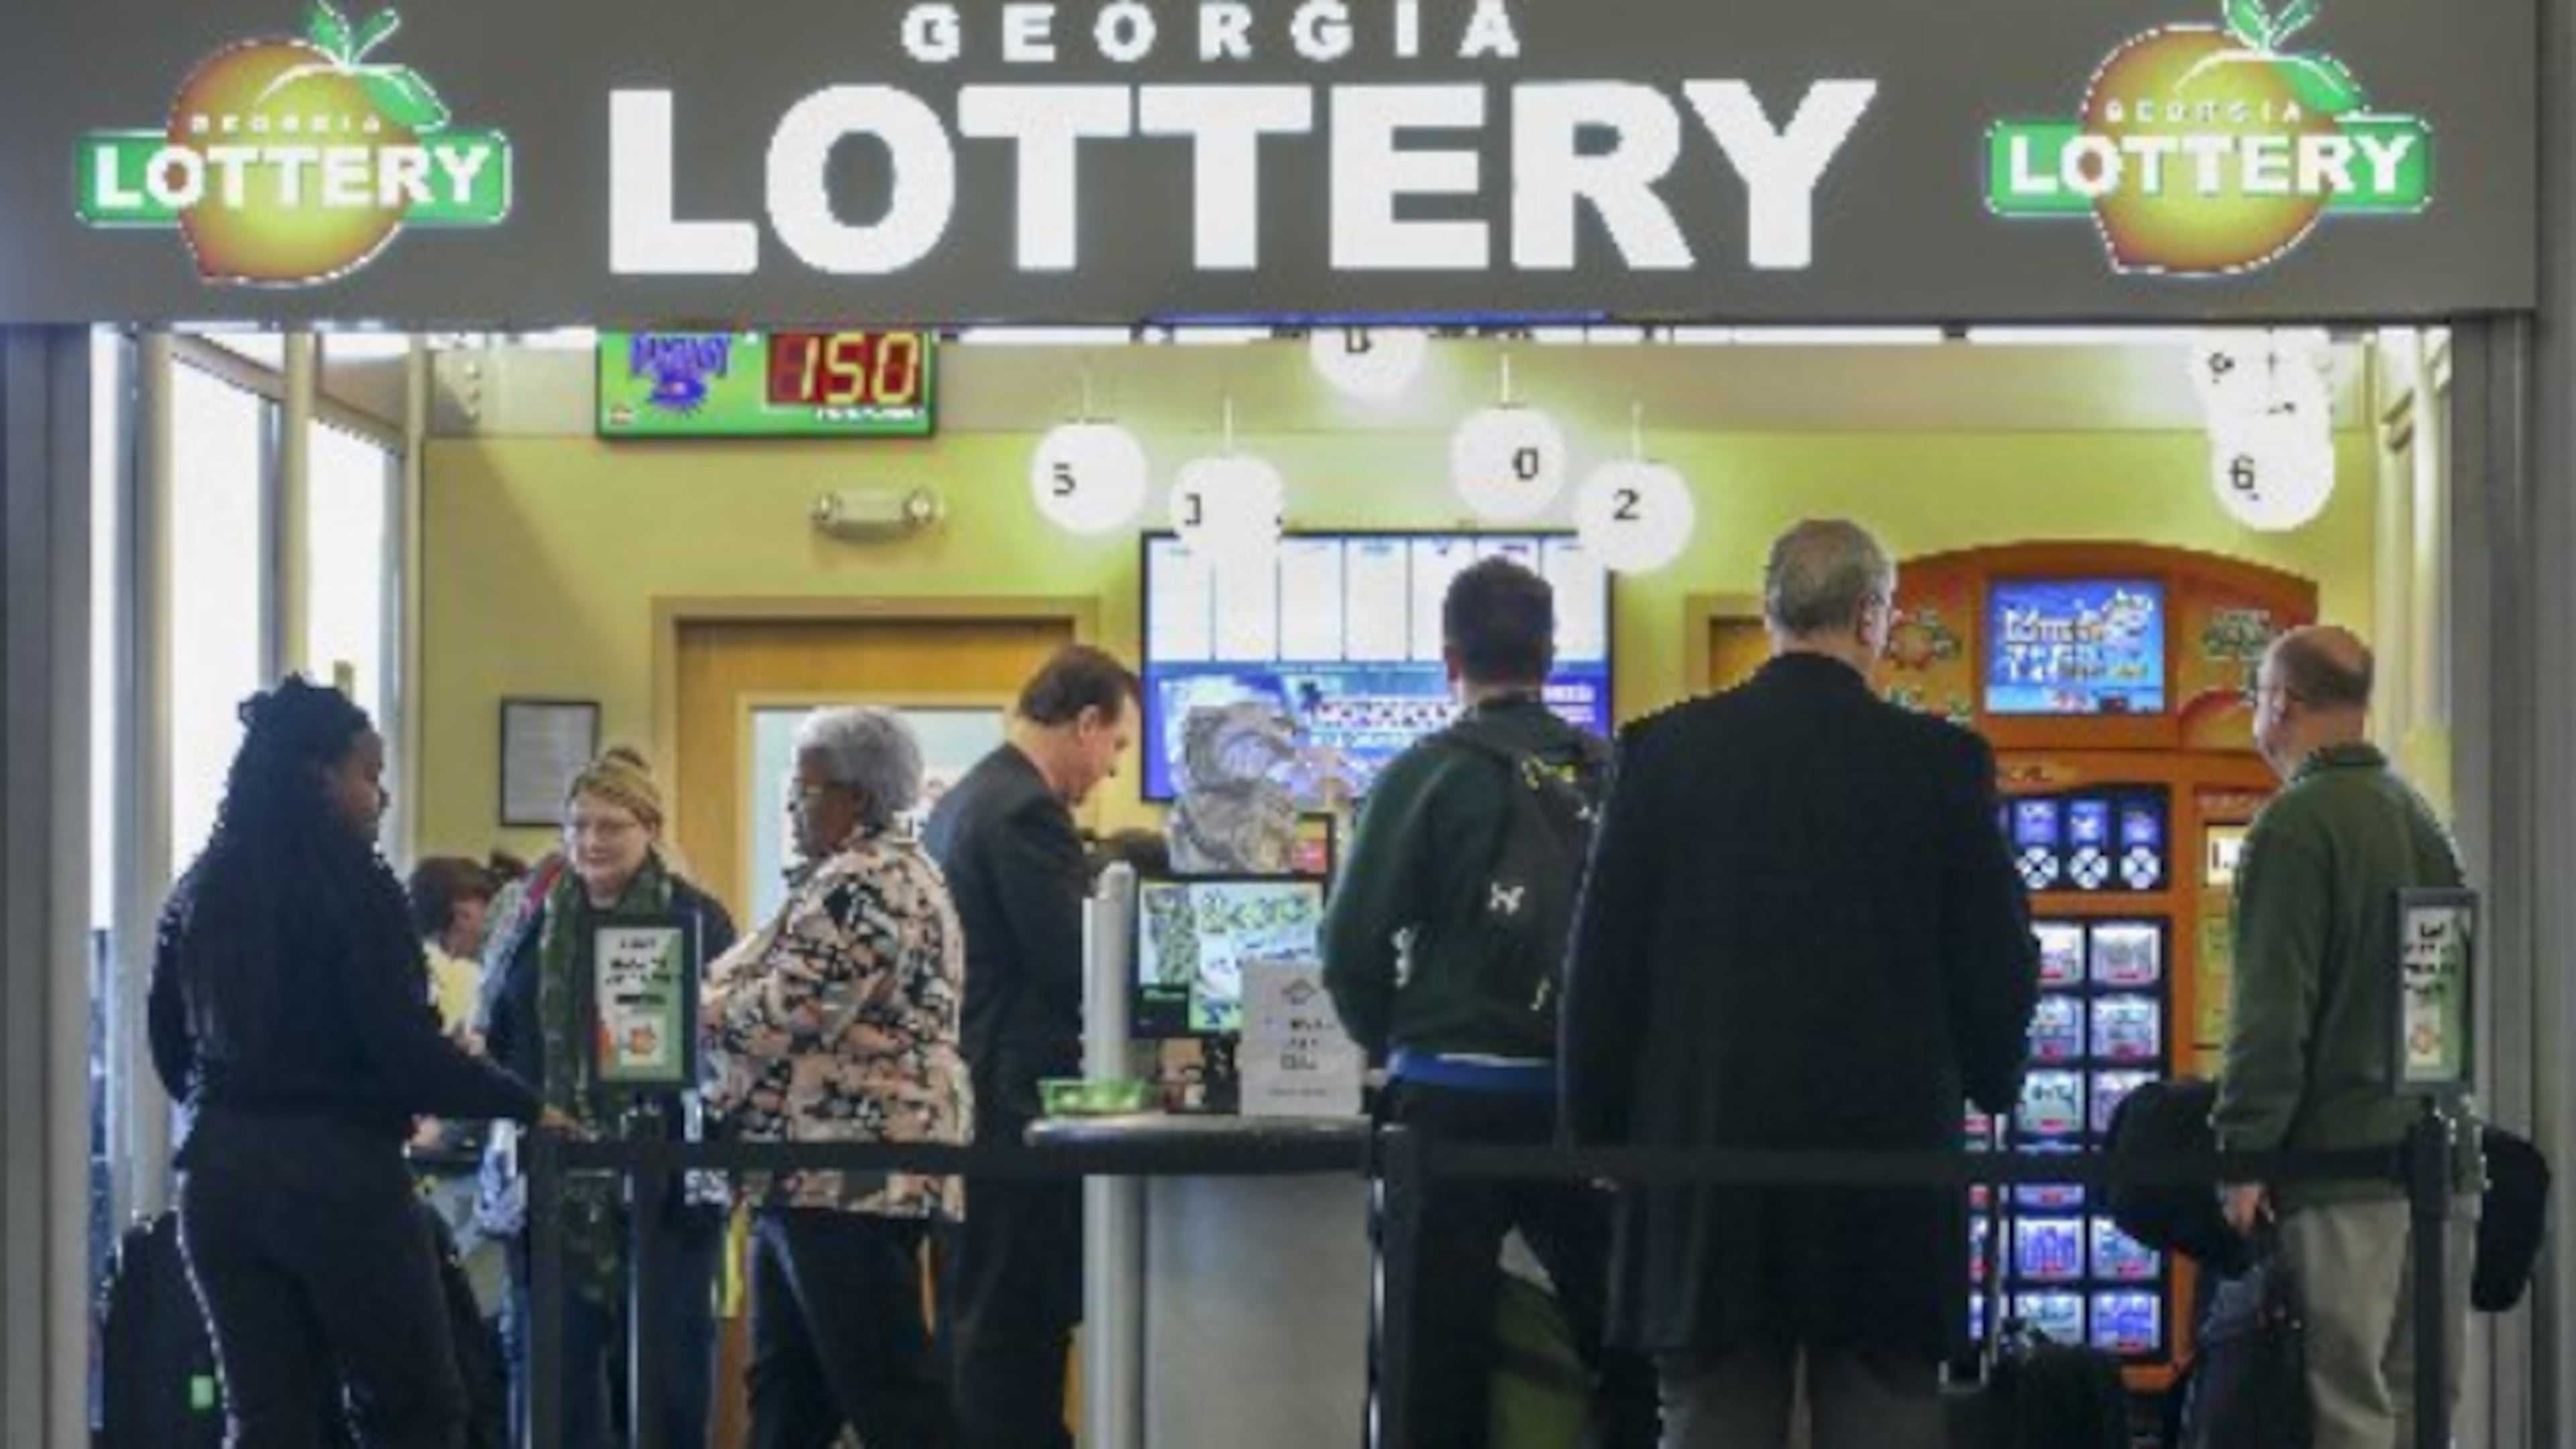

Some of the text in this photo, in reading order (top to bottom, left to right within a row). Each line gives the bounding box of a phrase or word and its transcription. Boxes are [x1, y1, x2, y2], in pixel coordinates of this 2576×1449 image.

[901, 0, 1521, 62] GEORGIA
[2104, 100, 2303, 123] GEORGIA
[95, 144, 491, 208] LOTTERY
[608, 79, 1877, 274] LOTTERY
[2010, 133, 2416, 195] LOTTERY
[802, 333, 919, 404] 150
[1611, 488, 1641, 521] 2
